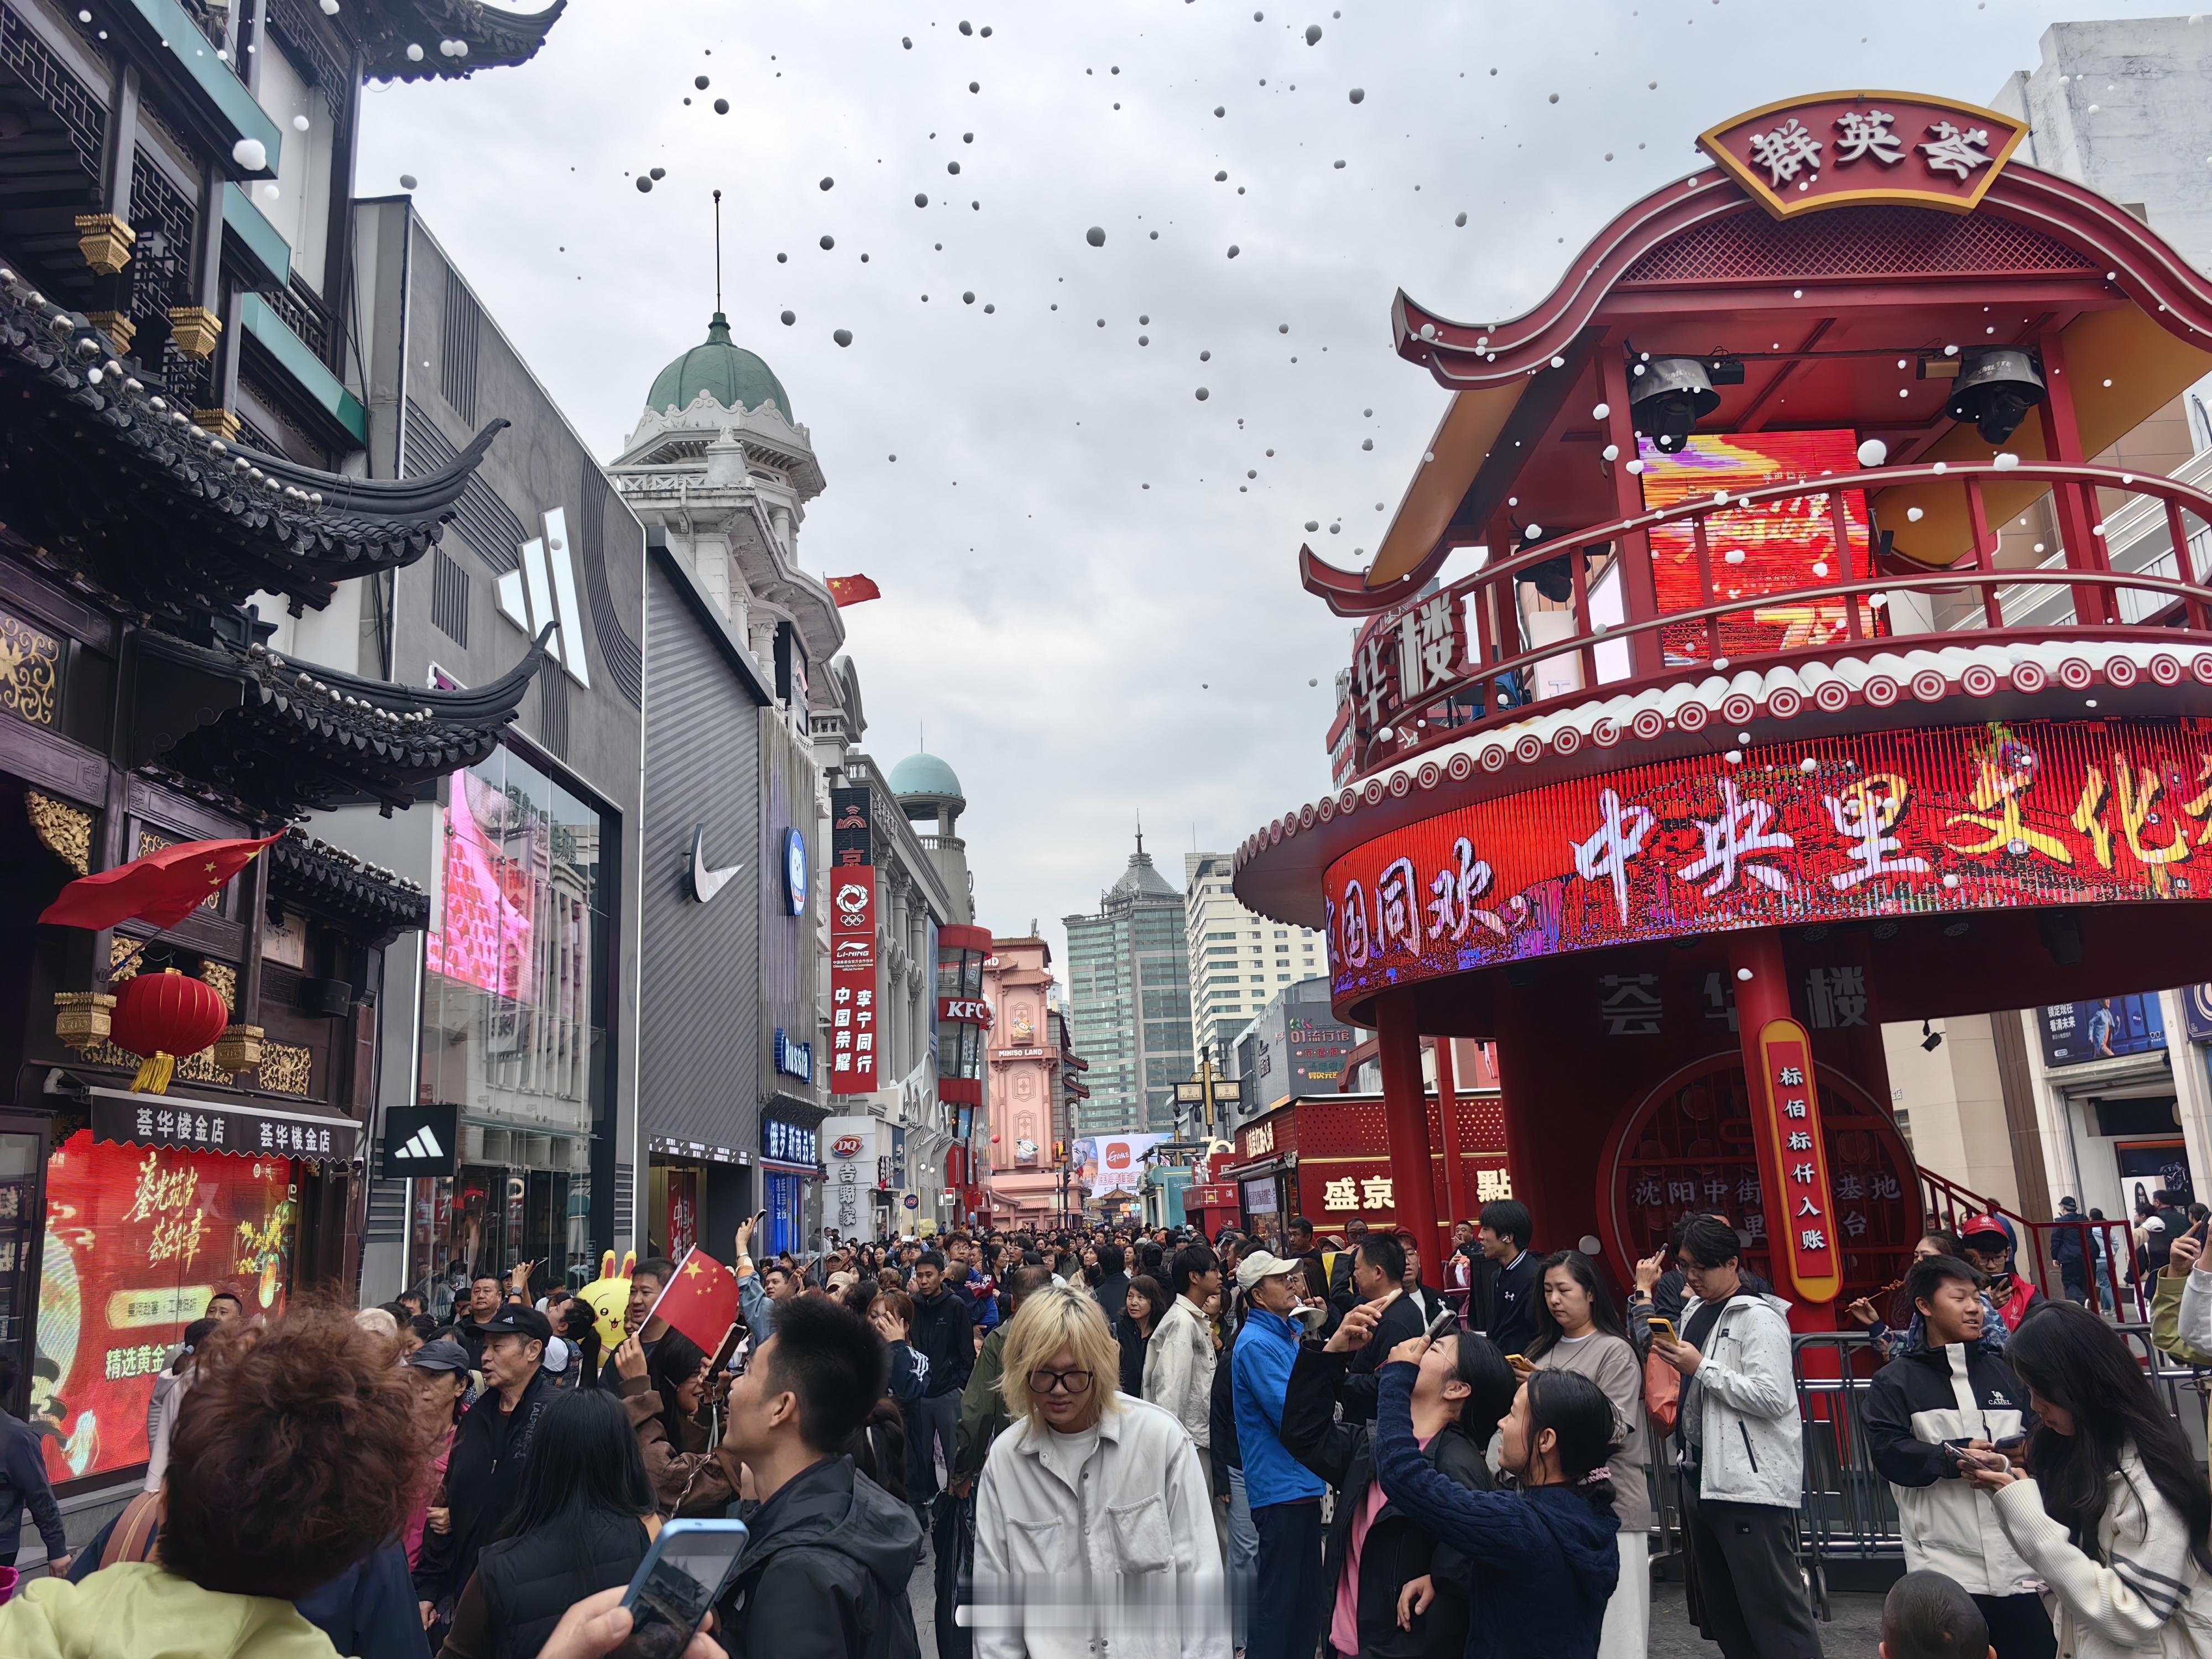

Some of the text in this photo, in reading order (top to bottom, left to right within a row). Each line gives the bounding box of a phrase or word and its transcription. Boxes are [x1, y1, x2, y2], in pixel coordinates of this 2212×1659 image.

[1751, 109, 1994, 188] 群英荟
[947, 1001, 984, 1019] KFC
[2049, 1016, 2075, 1032] 看清未来
[834, 987, 851, 1072] 中国荣耀
[856, 989, 873, 1073] 李宁同行
[1291, 1029, 1350, 1044] 01流行馆
[785, 1037, 808, 1078] Russia
[137, 1108, 225, 1144] 荟华楼金店
[260, 1122, 331, 1153] 荟华楼金店
[770, 1120, 816, 1164] 俄罗斯商品馆
[839, 1140, 857, 1151] DQ
[1777, 1067, 1827, 1251] 标佰标仟入账
[839, 1162, 857, 1226] 吉野家
[1323, 1175, 1395, 1210] 盛京
[1636, 1175, 1902, 1206] 沈阳中街基地
